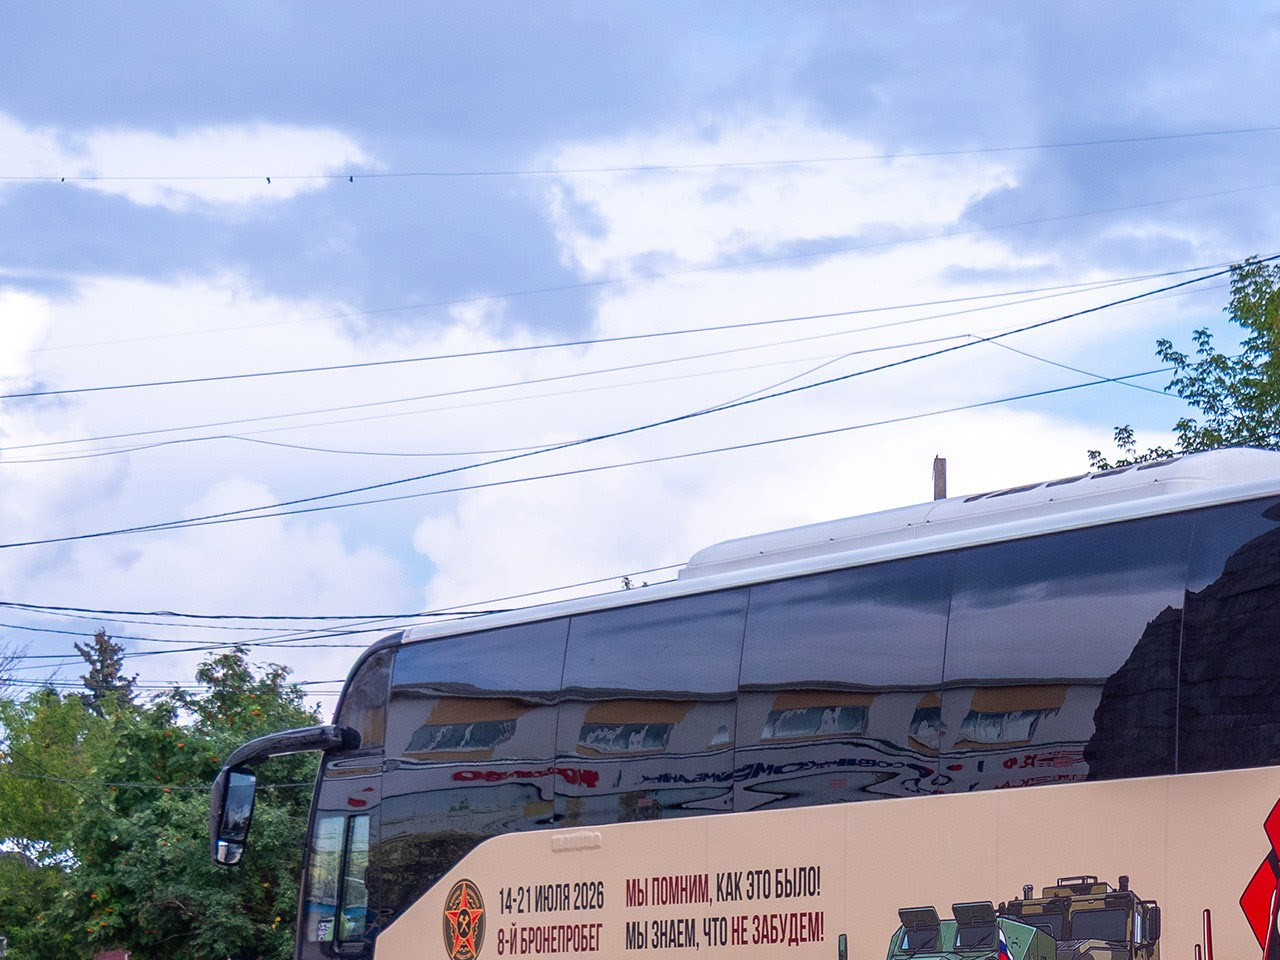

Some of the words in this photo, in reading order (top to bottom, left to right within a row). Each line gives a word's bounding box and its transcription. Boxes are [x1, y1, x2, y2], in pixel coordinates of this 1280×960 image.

[499, 885, 531, 915] 14-21
[535, 883, 571, 912] ИЮЛЯ
[573, 881, 604, 910] 2026
[626, 879, 648, 908] МЫ
[652, 873, 713, 908] ПОМНИМ,
[716, 871, 743, 902] КАК
[746, 869, 772, 900] ЭТО
[775, 865, 821, 898] БЫЛО!
[496, 922, 518, 956] 8-Й
[519, 923, 603, 955] БРОНЕПРОБЕГ
[626, 921, 649, 950] МЫ
[651, 918, 700, 952] ЗНАЕМ,
[702, 917, 728, 946] ЧТО
[731, 915, 748, 946] НЕ
[751, 911, 824, 948] ЗАБУДЕМ!
